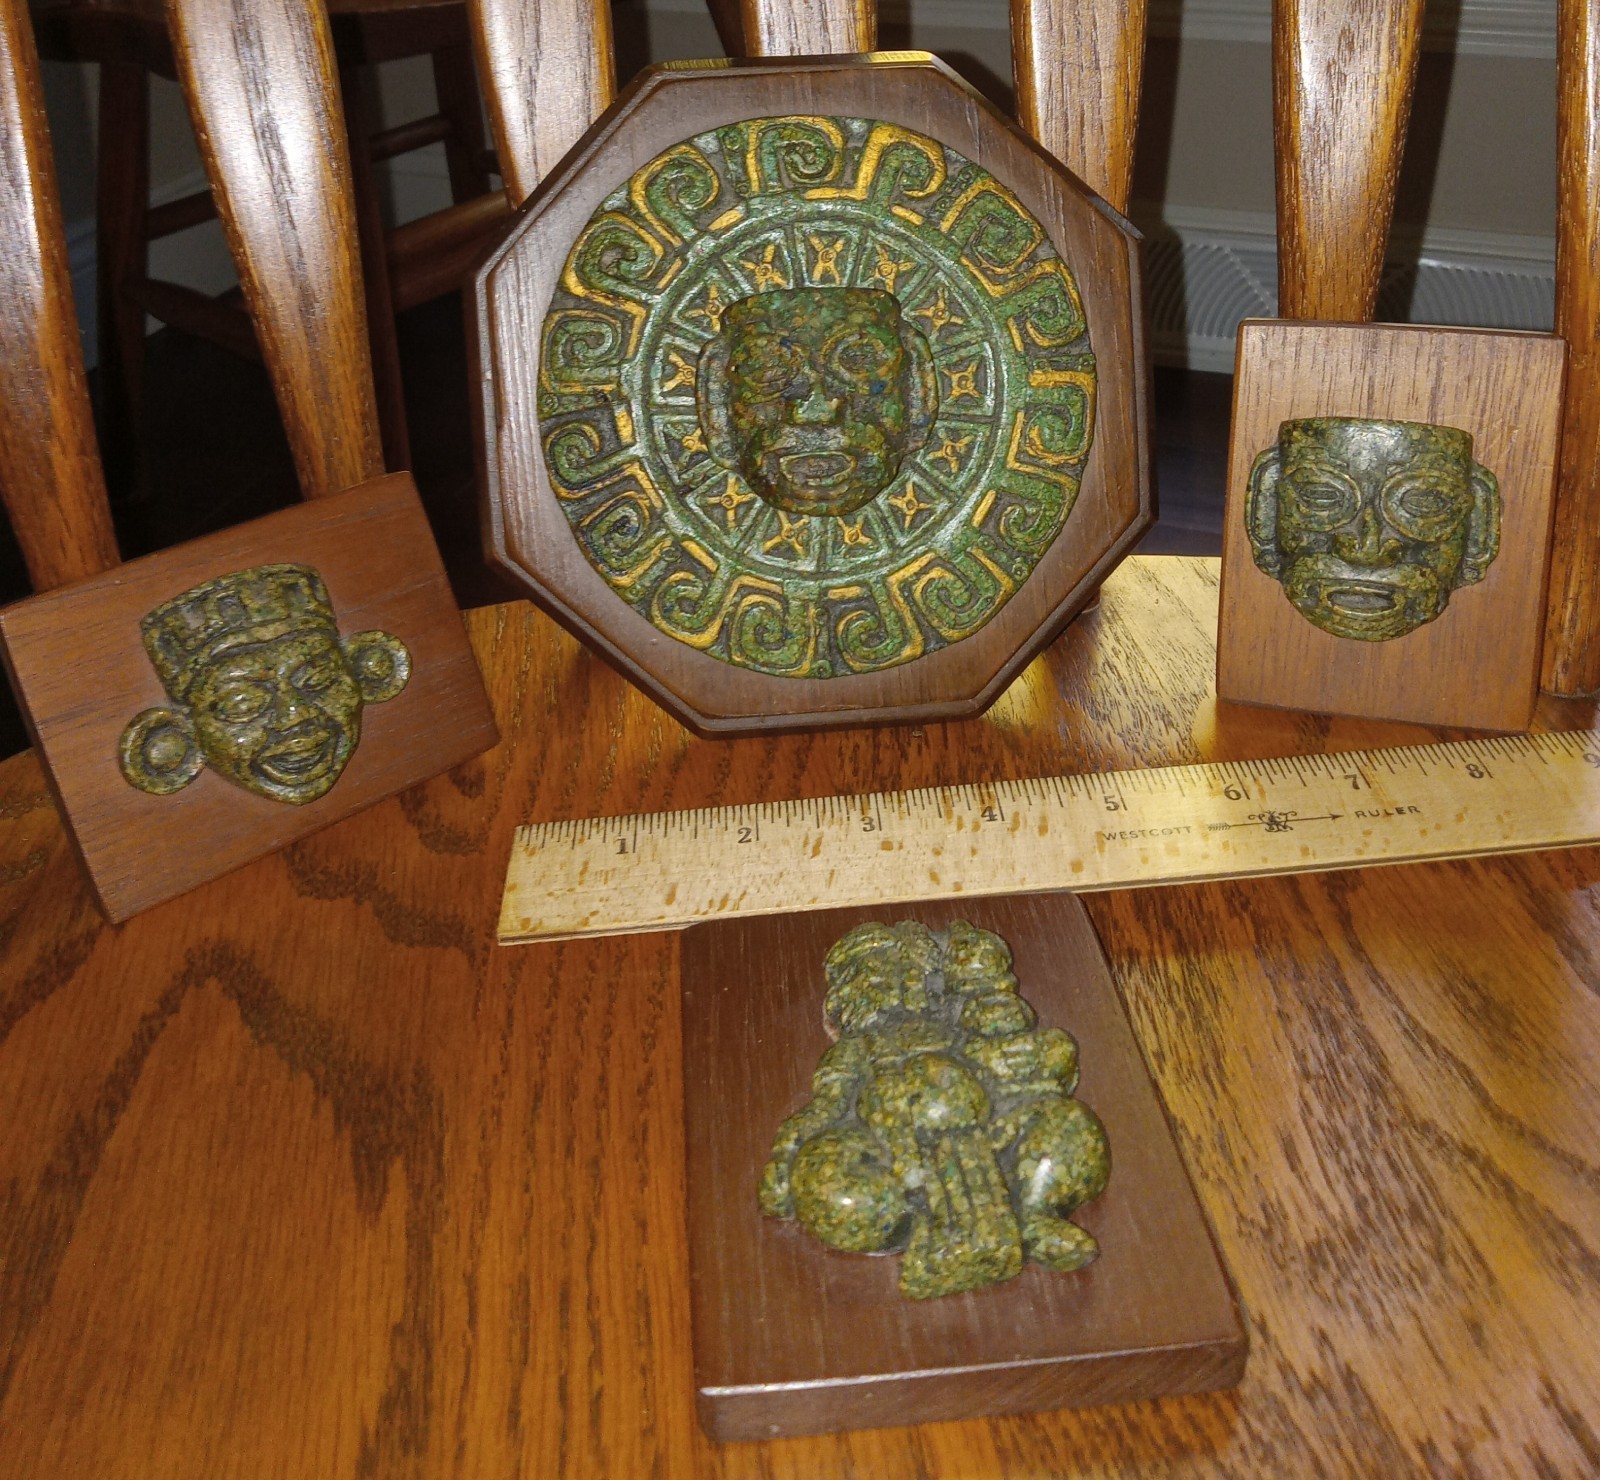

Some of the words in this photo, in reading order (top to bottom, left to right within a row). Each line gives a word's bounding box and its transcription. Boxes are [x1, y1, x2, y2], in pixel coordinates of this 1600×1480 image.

[614, 837, 629, 855] 1
[738, 827, 752, 843] 2
[860, 816, 875, 832] 3
[981, 806, 998, 821] 4
[1104, 795, 1119, 811] 5
[1224, 784, 1242, 800] 6
[1344, 774, 1360, 790] 7
[1465, 763, 1484, 779] 8
[1103, 826, 1192, 841] WESTCOTT
[1355, 805, 1421, 818] RULER
